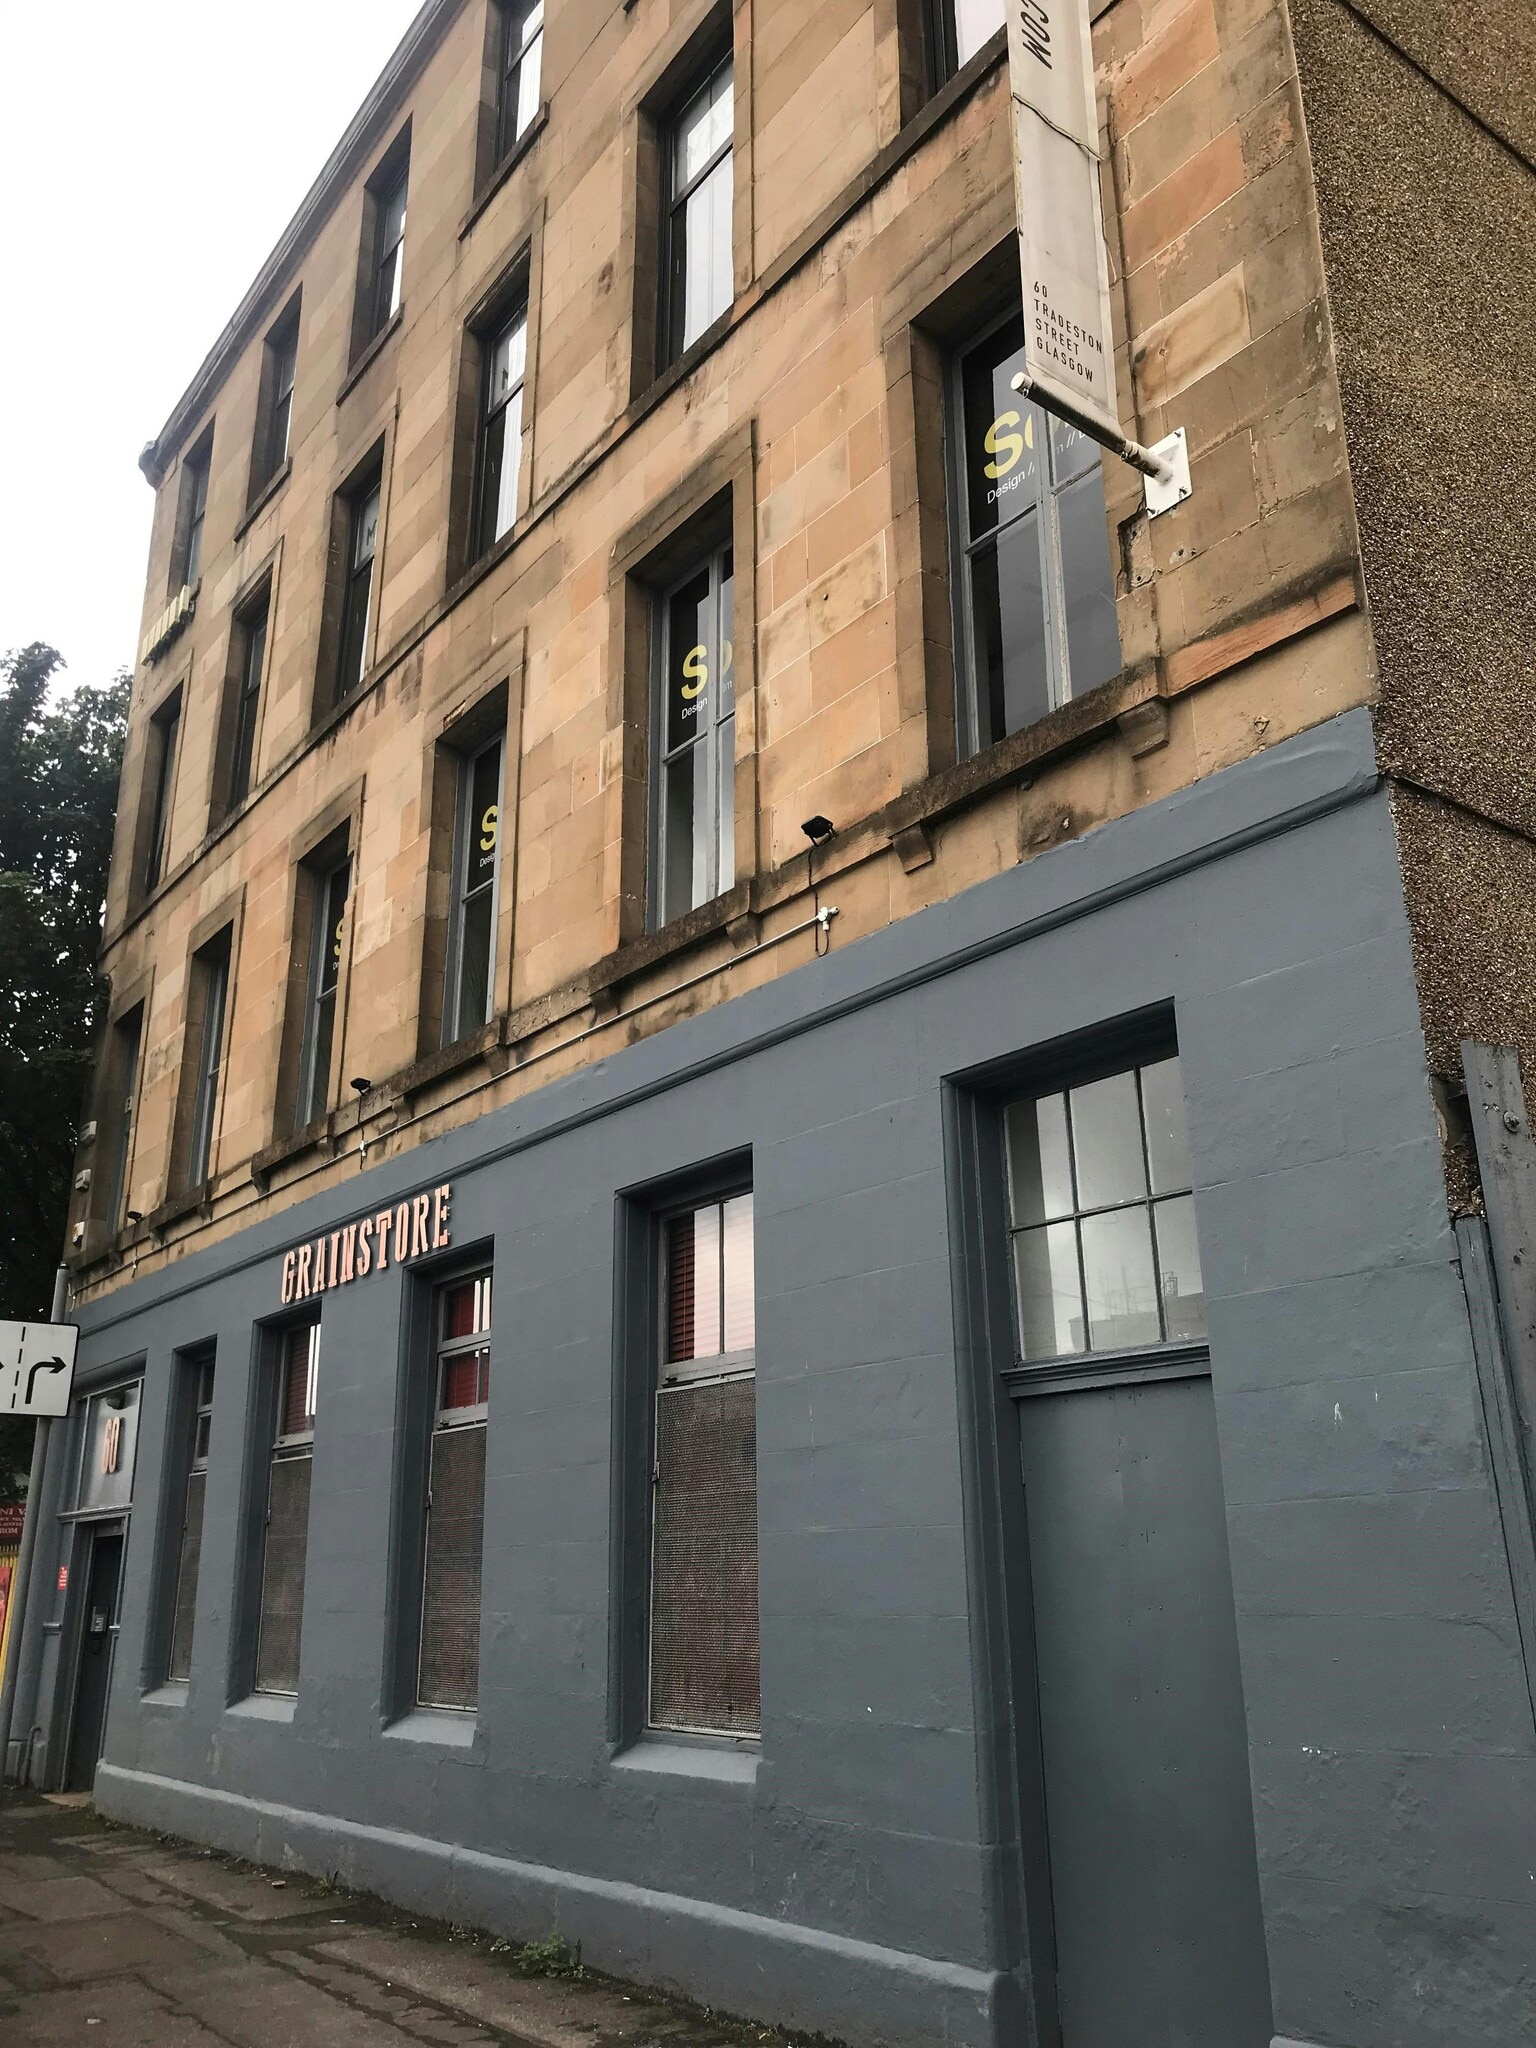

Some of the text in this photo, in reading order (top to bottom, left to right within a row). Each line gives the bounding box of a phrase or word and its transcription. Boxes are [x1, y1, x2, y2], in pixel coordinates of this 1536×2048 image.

[1034, 281, 1047, 298] 60
[1034, 299, 1102, 354] TRADESTON
[1036, 318, 1079, 355] STREET
[1037, 337, 1093, 382] GLASGOW
[987, 471, 1025, 504] Design
[681, 697, 708, 720] Design
[281, 1184, 450, 1304] GRAINSTORE
[102, 1417, 120, 1474] 60
